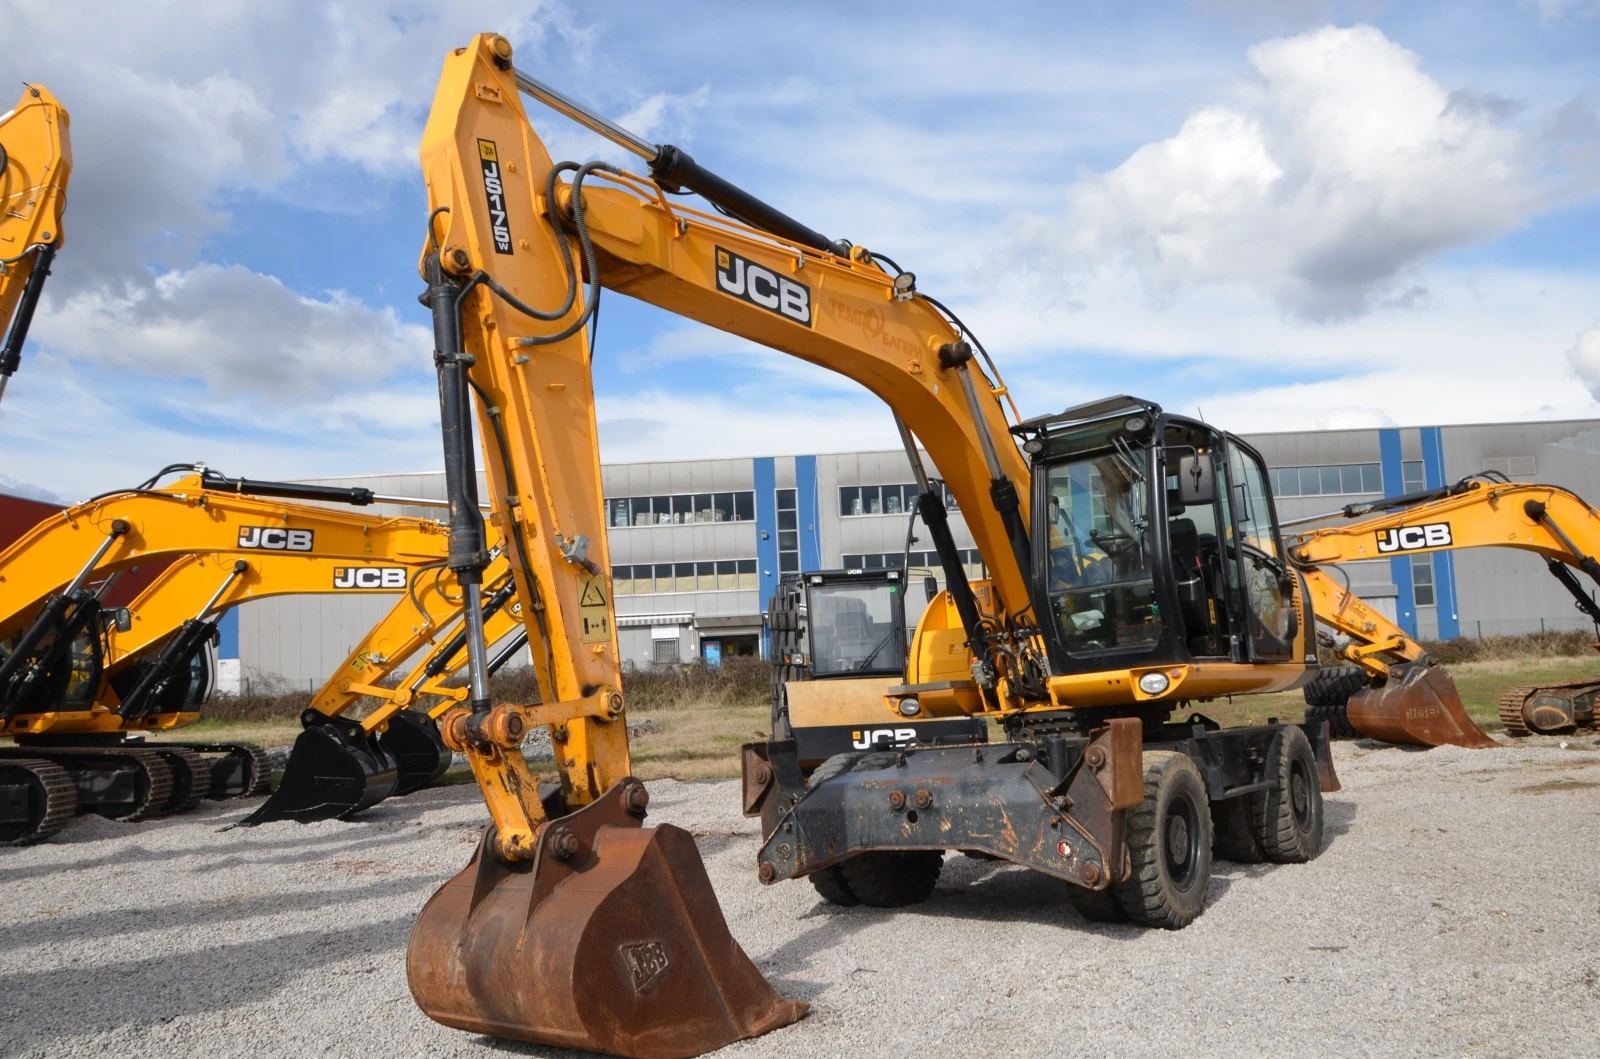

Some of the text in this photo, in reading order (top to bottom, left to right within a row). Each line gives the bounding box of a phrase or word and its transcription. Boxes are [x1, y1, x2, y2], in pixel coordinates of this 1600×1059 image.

[718, 257, 810, 322] JCB
[239, 527, 312, 551] JCB
[1378, 524, 1451, 552] JCB
[335, 568, 406, 588] JCB
